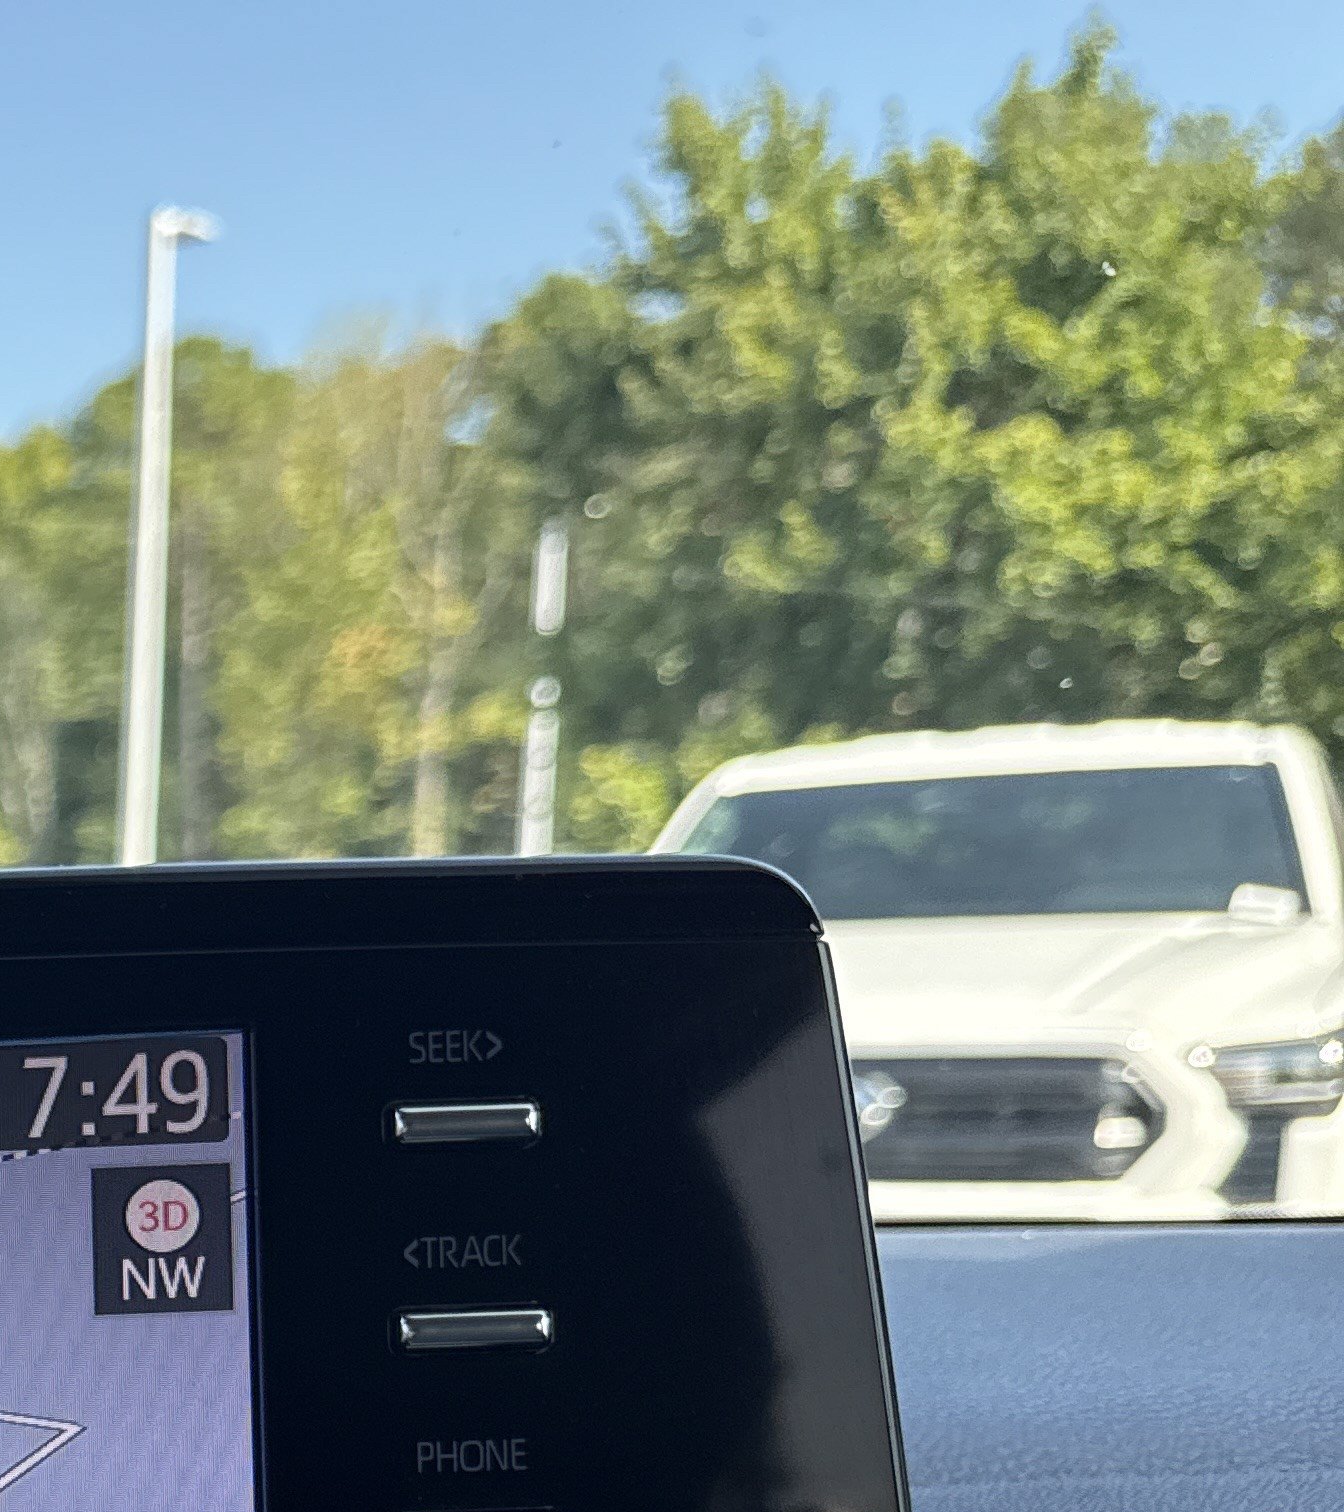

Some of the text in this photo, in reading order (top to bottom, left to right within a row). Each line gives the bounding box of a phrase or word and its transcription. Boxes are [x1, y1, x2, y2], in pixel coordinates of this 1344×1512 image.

[22, 1051, 210, 1138] 7:49
[137, 1201, 188, 1232] 3D
[122, 1256, 205, 1300] NW
[417, 1438, 528, 1473] PHONE
